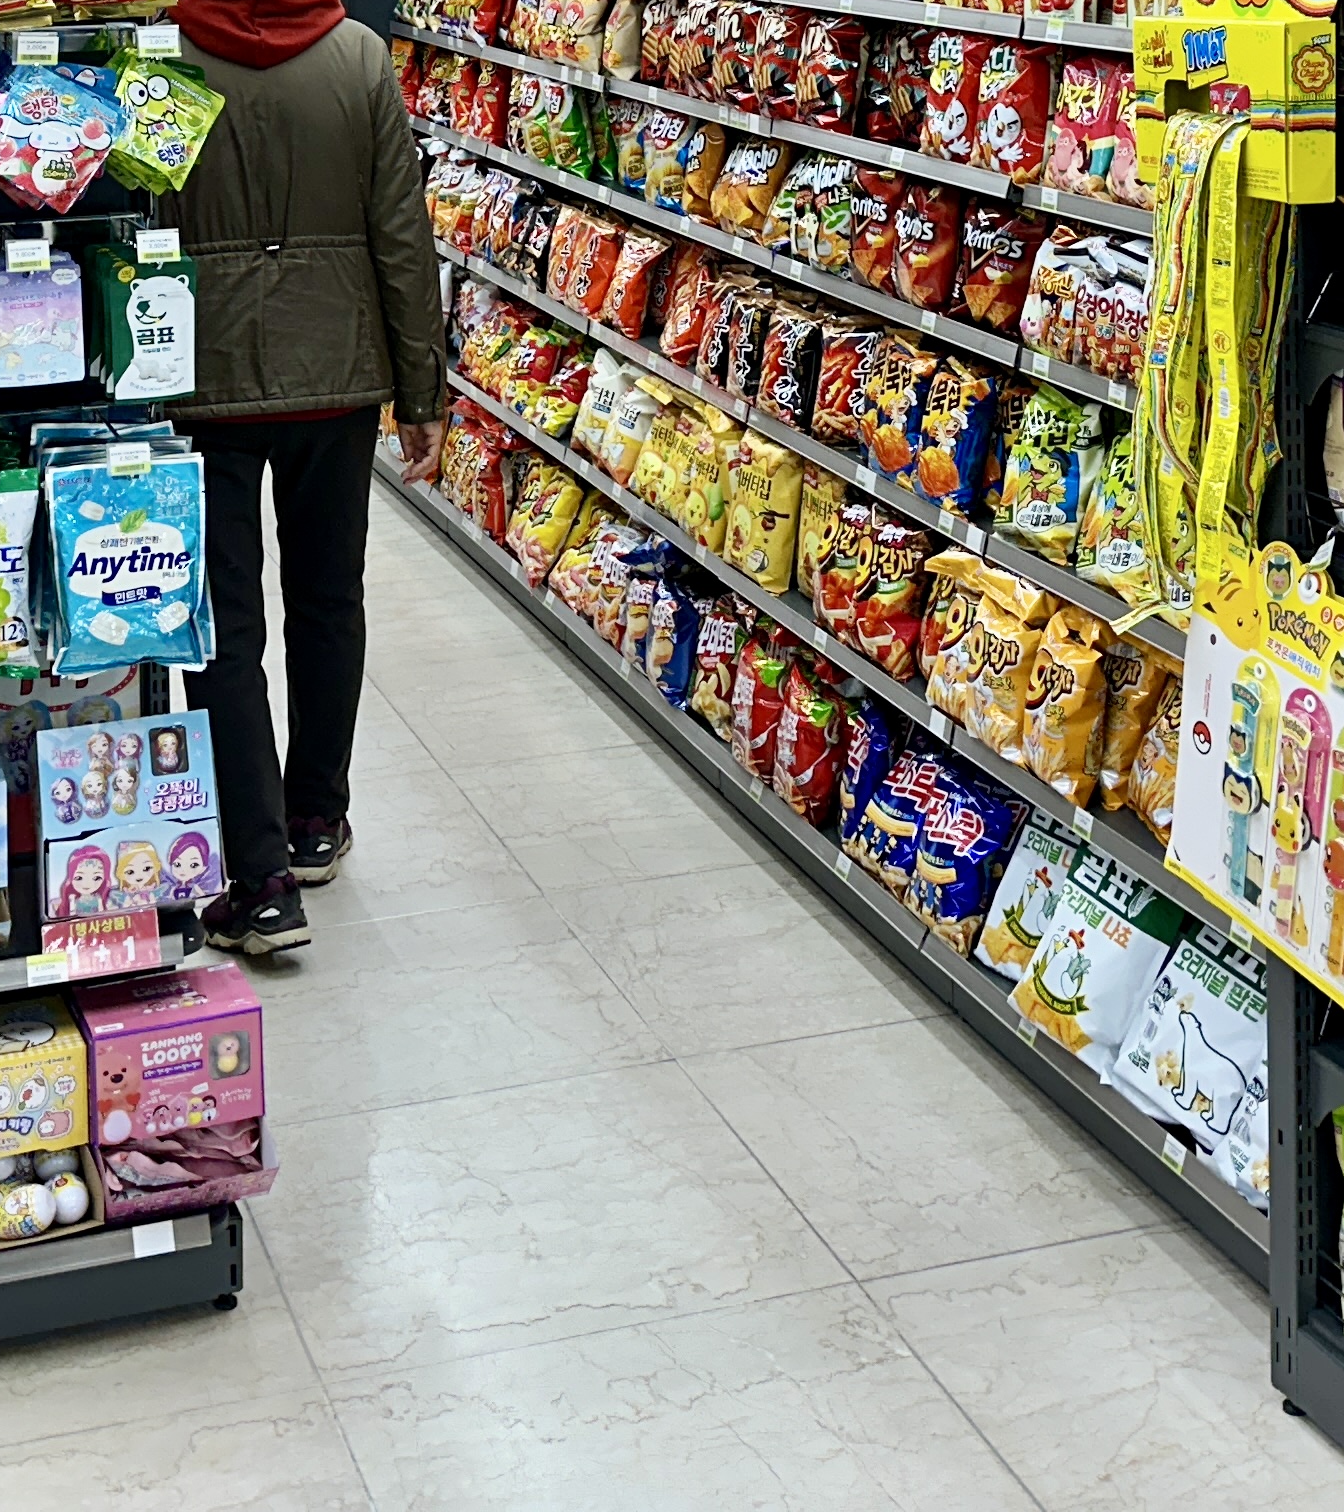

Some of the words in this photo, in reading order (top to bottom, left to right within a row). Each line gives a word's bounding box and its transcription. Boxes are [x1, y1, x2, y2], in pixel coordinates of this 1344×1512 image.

[137, 327, 175, 345] 곰표
[67, 546, 191, 583] Anytime
[115, 588, 148, 604] 민트맛
[1076, 851, 1133, 913] 곰표
[69, 916, 131, 938] [행사상품]
[1102, 915, 1133, 949] 나쵸
[1173, 947, 1226, 997] 오리지널
[141, 1032, 203, 1052] ZANMANG
[142, 1044, 204, 1067] LOOPY
